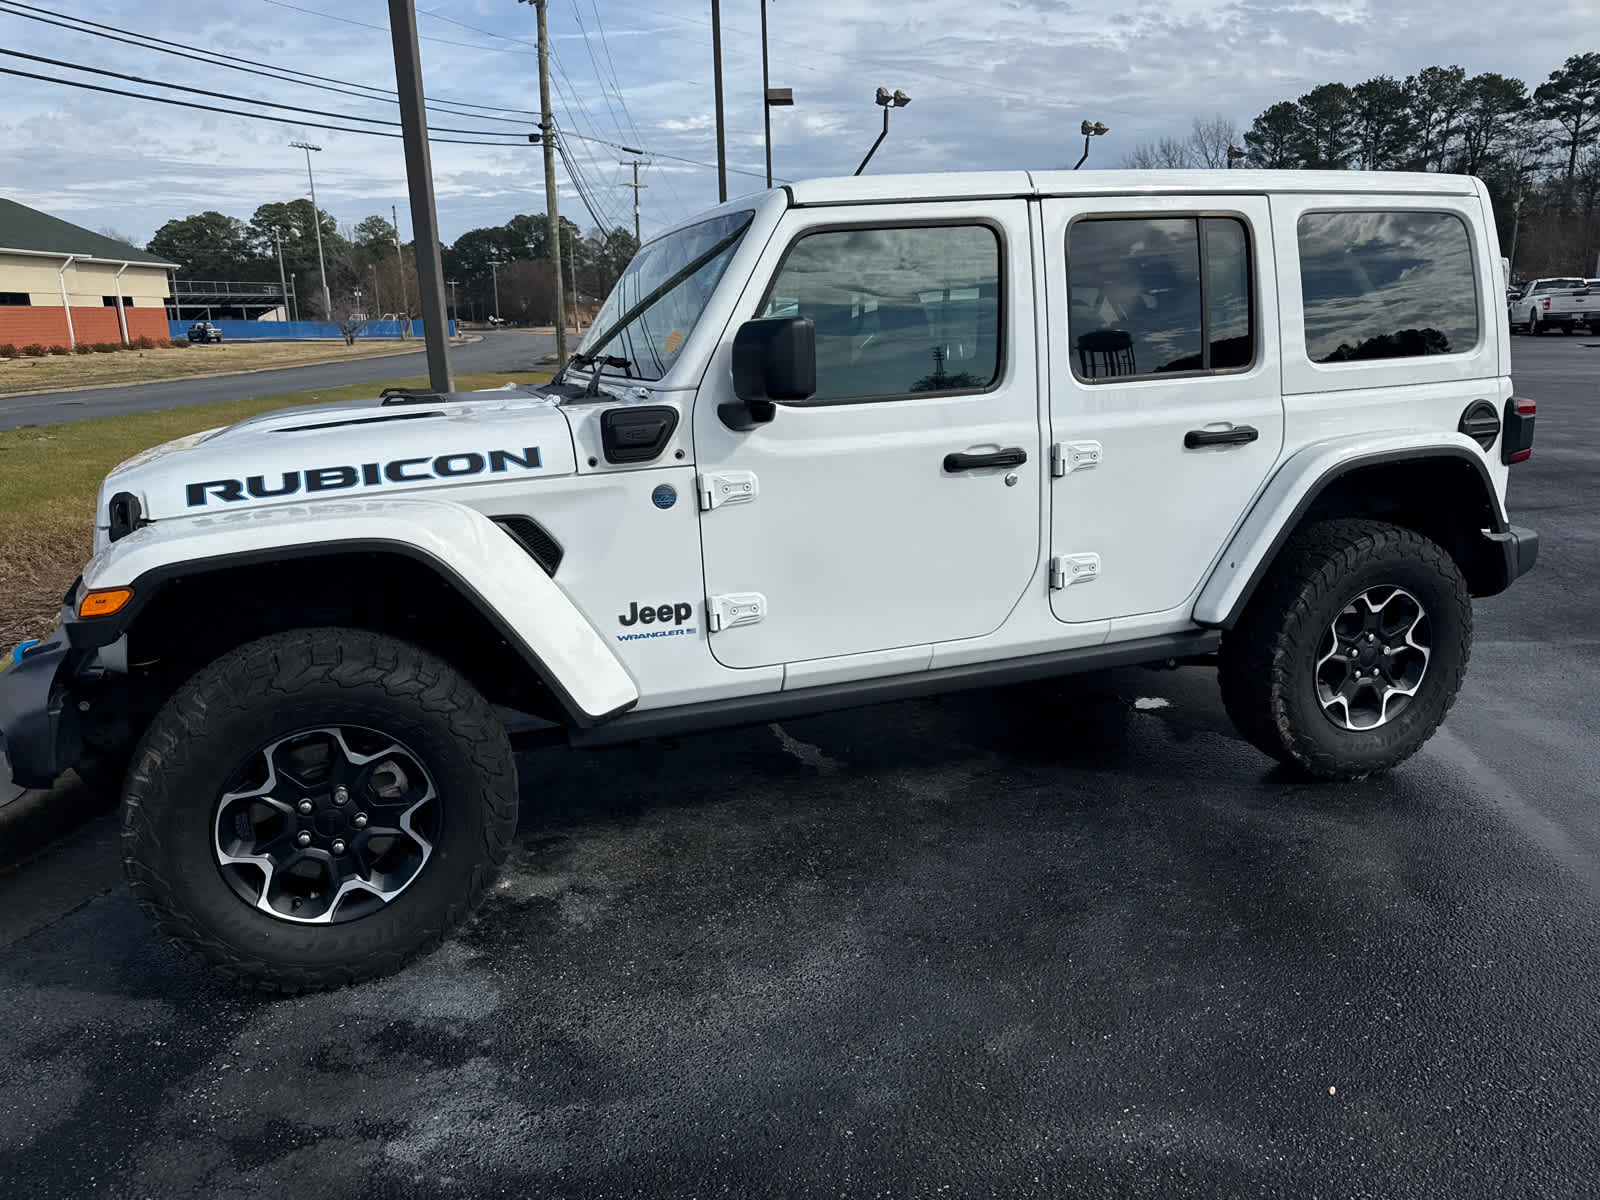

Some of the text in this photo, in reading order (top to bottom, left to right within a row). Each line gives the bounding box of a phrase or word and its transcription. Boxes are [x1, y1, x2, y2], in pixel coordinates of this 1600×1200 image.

[186, 446, 542, 507] RUBICON
[618, 602, 692, 626] Jeep
[617, 629, 685, 641] WRANGLER
